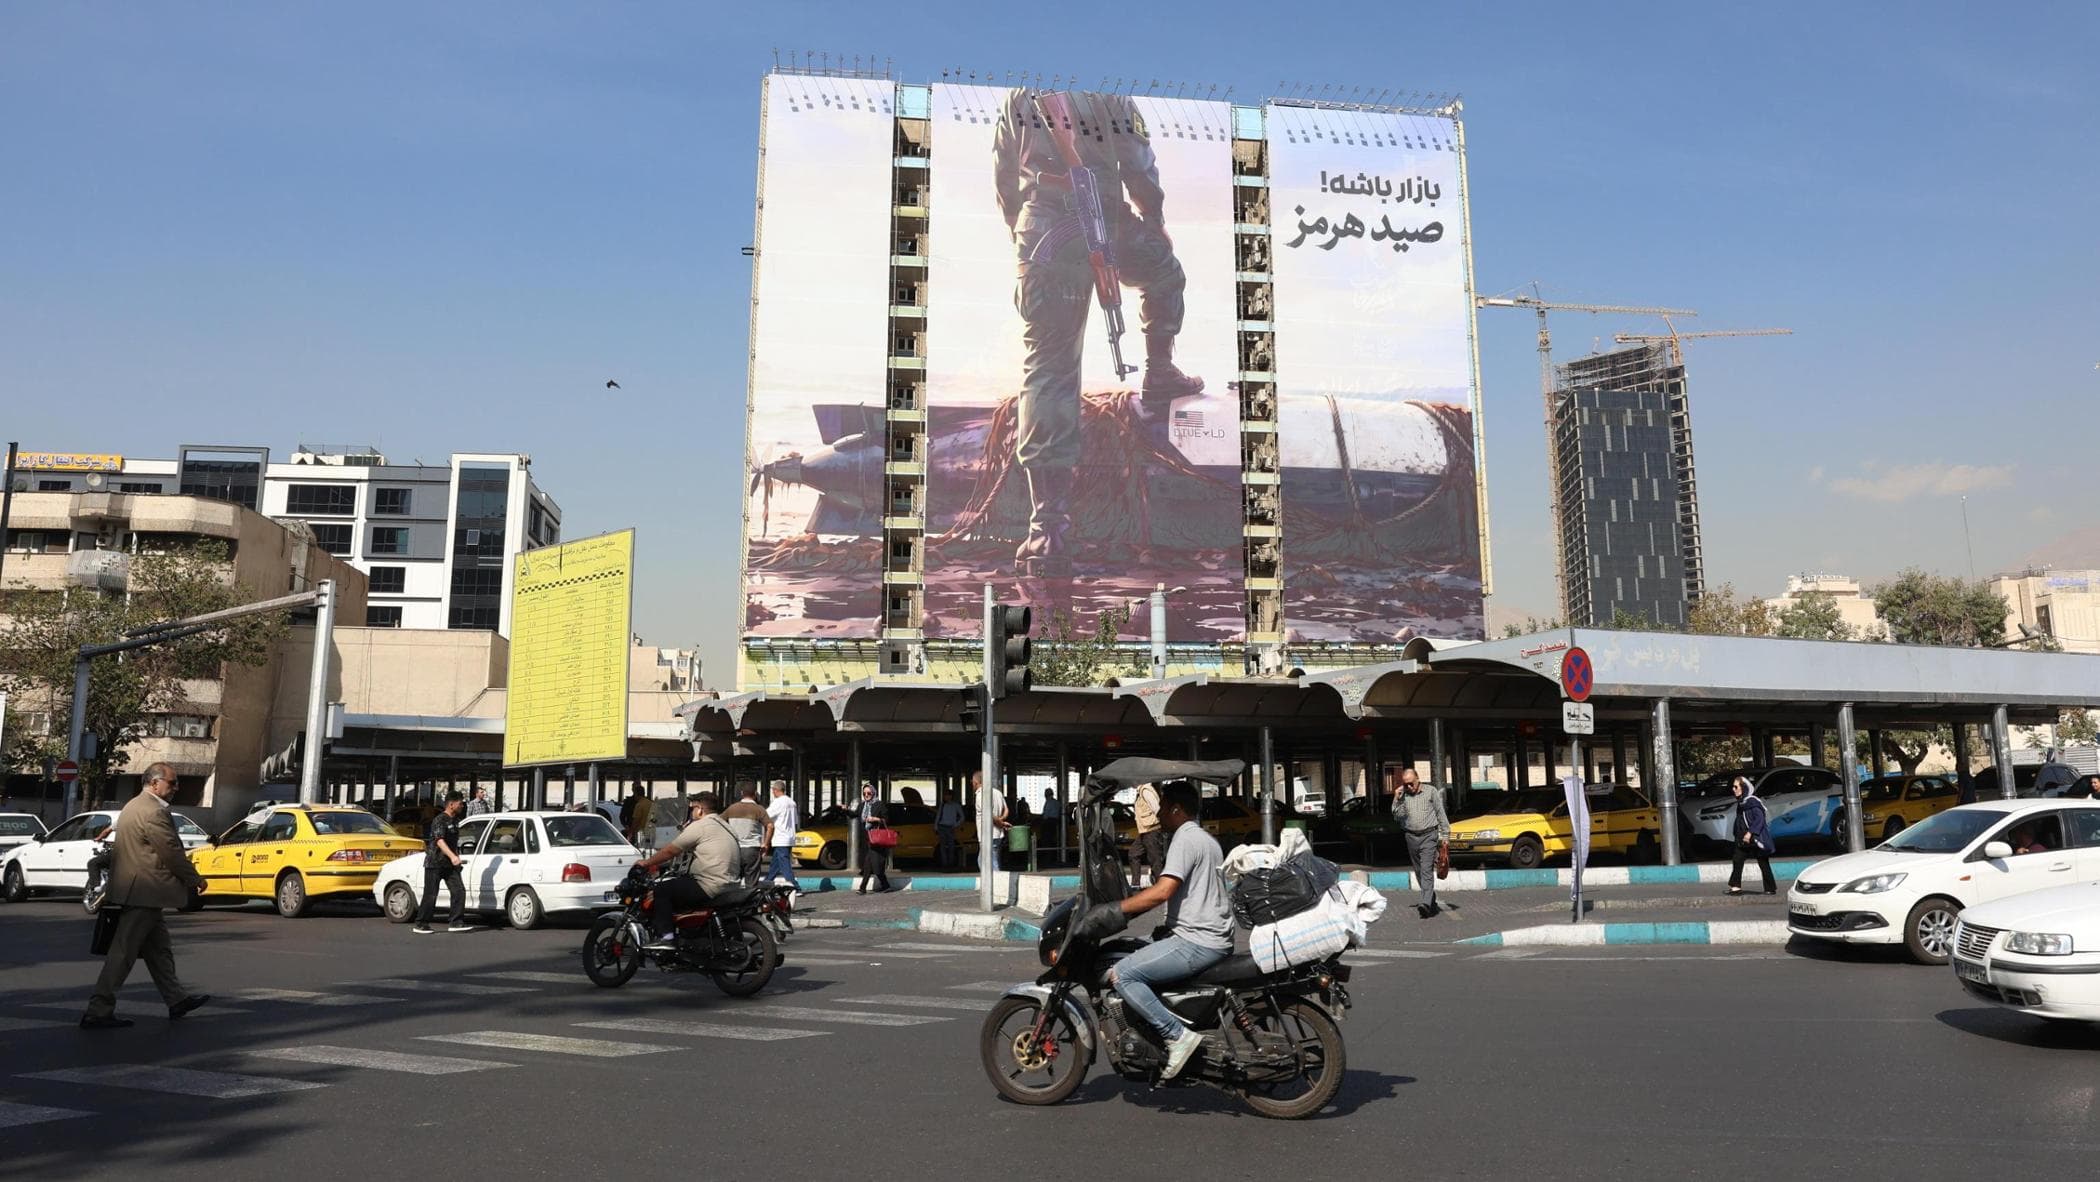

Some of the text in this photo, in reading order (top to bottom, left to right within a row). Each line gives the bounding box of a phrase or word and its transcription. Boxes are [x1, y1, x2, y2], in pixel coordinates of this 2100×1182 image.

[1321, 170, 1441, 207] بازار باشه!
[1284, 204, 1444, 253] صید هرمز
